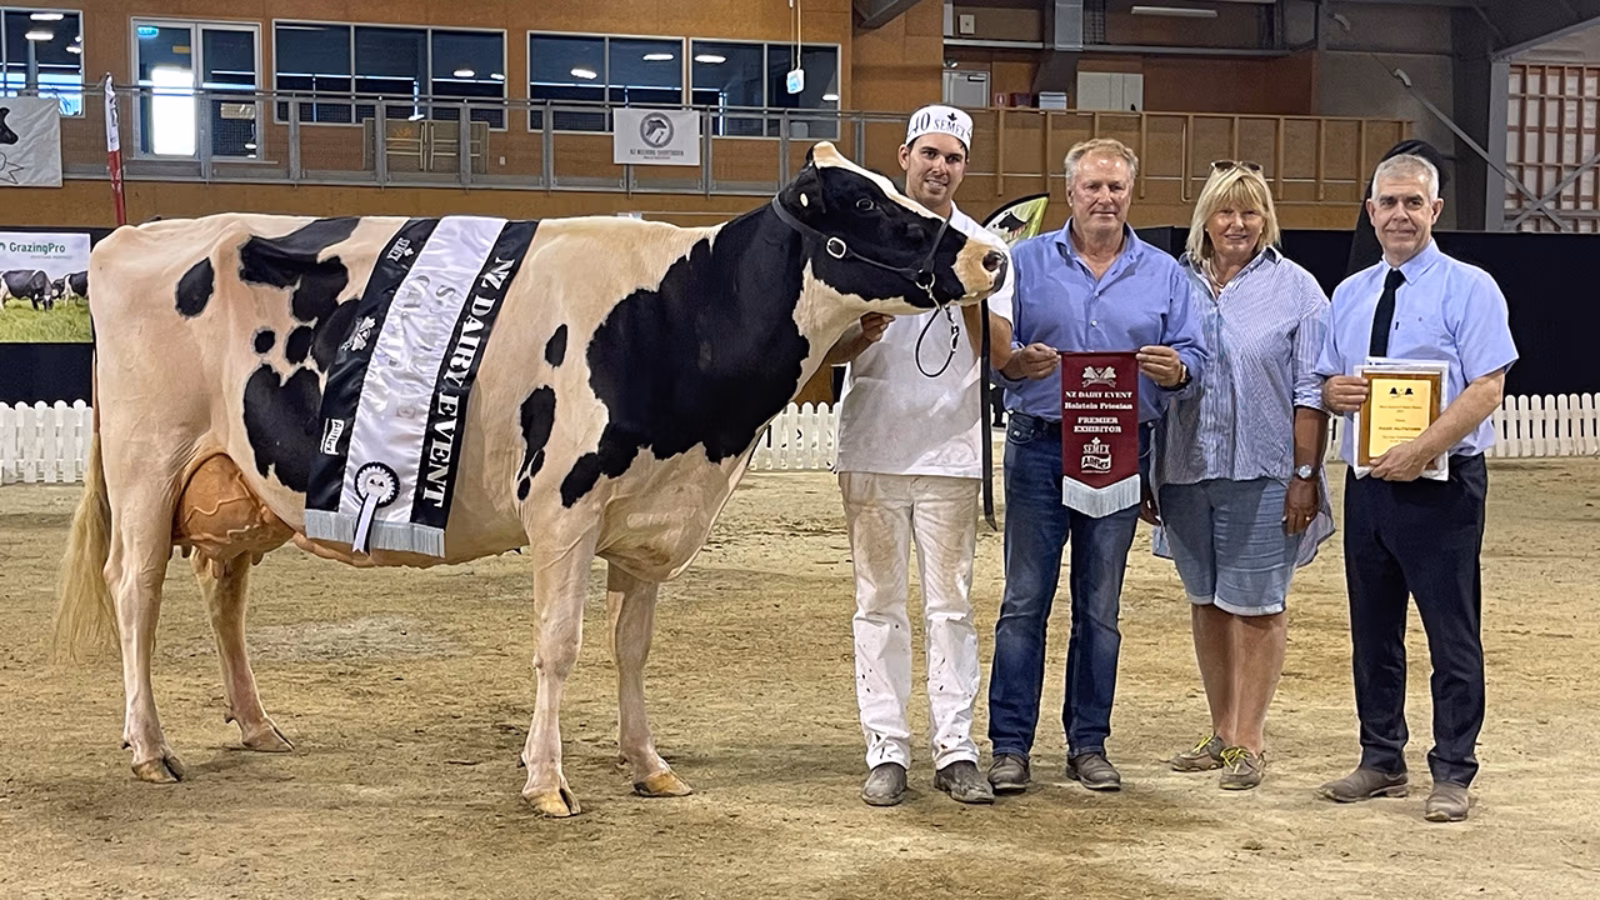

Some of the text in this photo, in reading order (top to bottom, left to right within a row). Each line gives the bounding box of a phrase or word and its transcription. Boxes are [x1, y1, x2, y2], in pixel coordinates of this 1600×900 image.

[934, 119, 966, 139] SEMEX
[9, 242, 66, 255] GrazingPro
[422, 257, 515, 508] NZ DAIRY EVENT
[1078, 416, 1118, 424] PREMIER
[1074, 425, 1122, 433] EXHIBITOR
[1083, 444, 1111, 454] SEMEX
